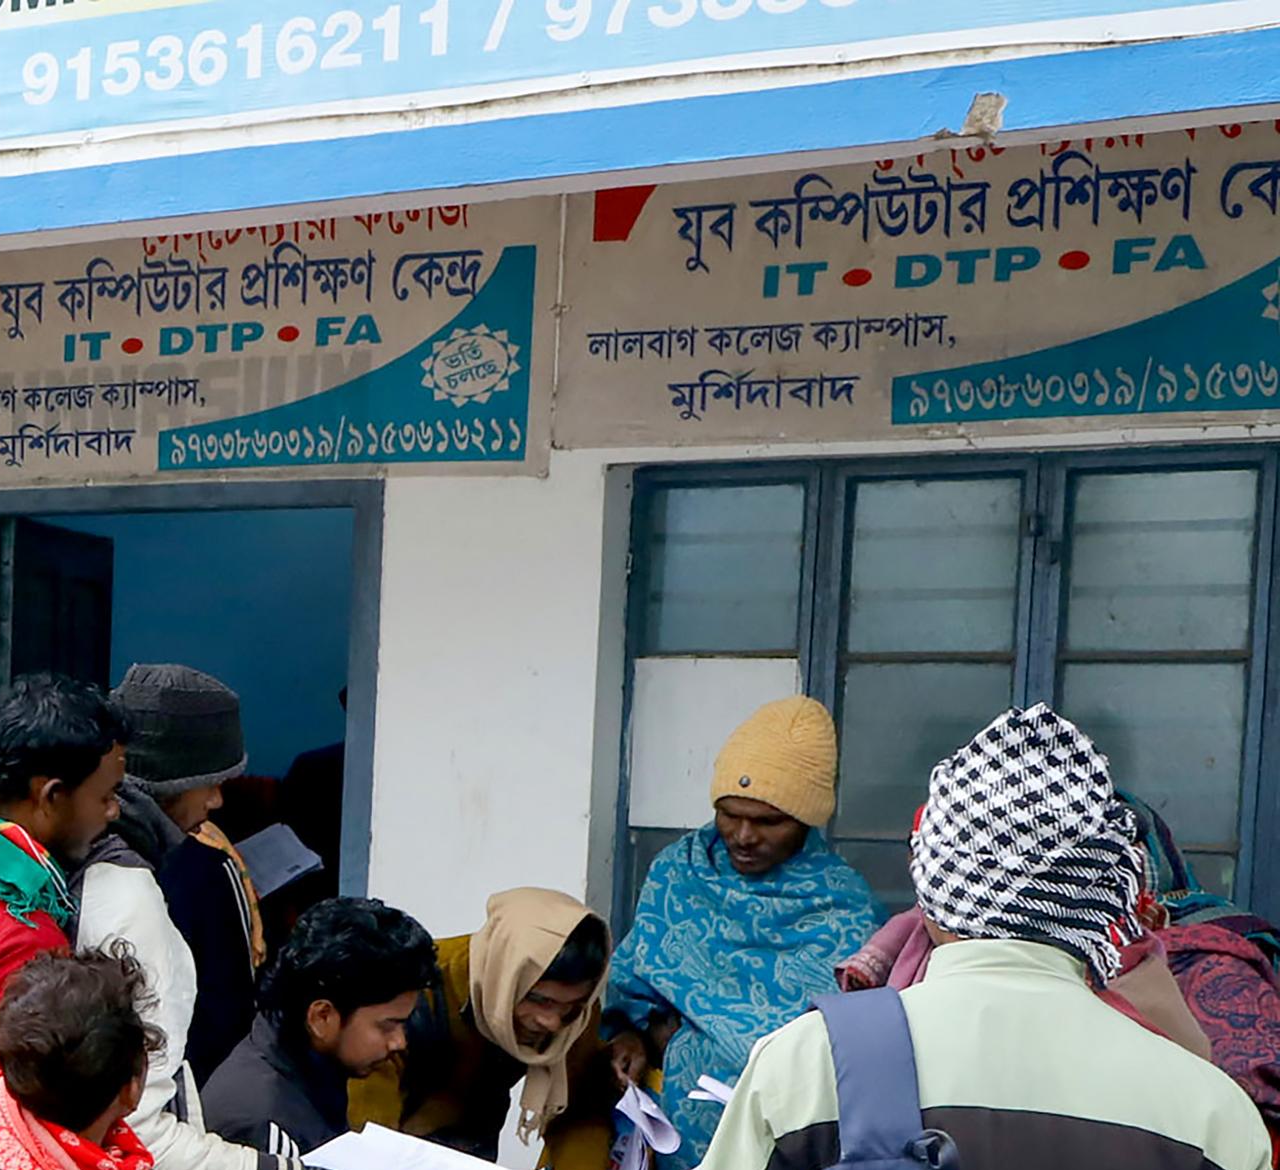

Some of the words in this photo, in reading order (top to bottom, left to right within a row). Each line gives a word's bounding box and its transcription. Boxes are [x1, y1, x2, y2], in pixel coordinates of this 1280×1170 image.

[22, 1, 449, 106] 9153616211
[673, 203, 737, 274] যুব
[749, 173, 990, 250] কম্পিউটার
[1006, 150, 1197, 231] প্রশিক্ষণ
[54, 254, 229, 324] কম্পিউটার
[240, 241, 375, 311] প্রশিক্ষণ
[392, 249, 483, 302] কেন্দ্র
[763, 261, 828, 299] IT
[894, 246, 1041, 289] DTP
[1112, 234, 1208, 275] FA
[63, 332, 111, 362] IT
[159, 321, 264, 356] DTP
[315, 314, 382, 347] FA
[442, 340, 484, 369] ভর্তি
[587, 325, 698, 362] লালবাগ
[704, 323, 803, 357] কলেজ
[811, 312, 956, 353] ক্যাম্পাস,
[22, 384, 95, 413] কলেজ
[99, 376, 206, 411] ক্যাম্পাস,
[443, 359, 502, 391] চলছে
[667, 369, 860, 421] মুর্শিদাবাদ
